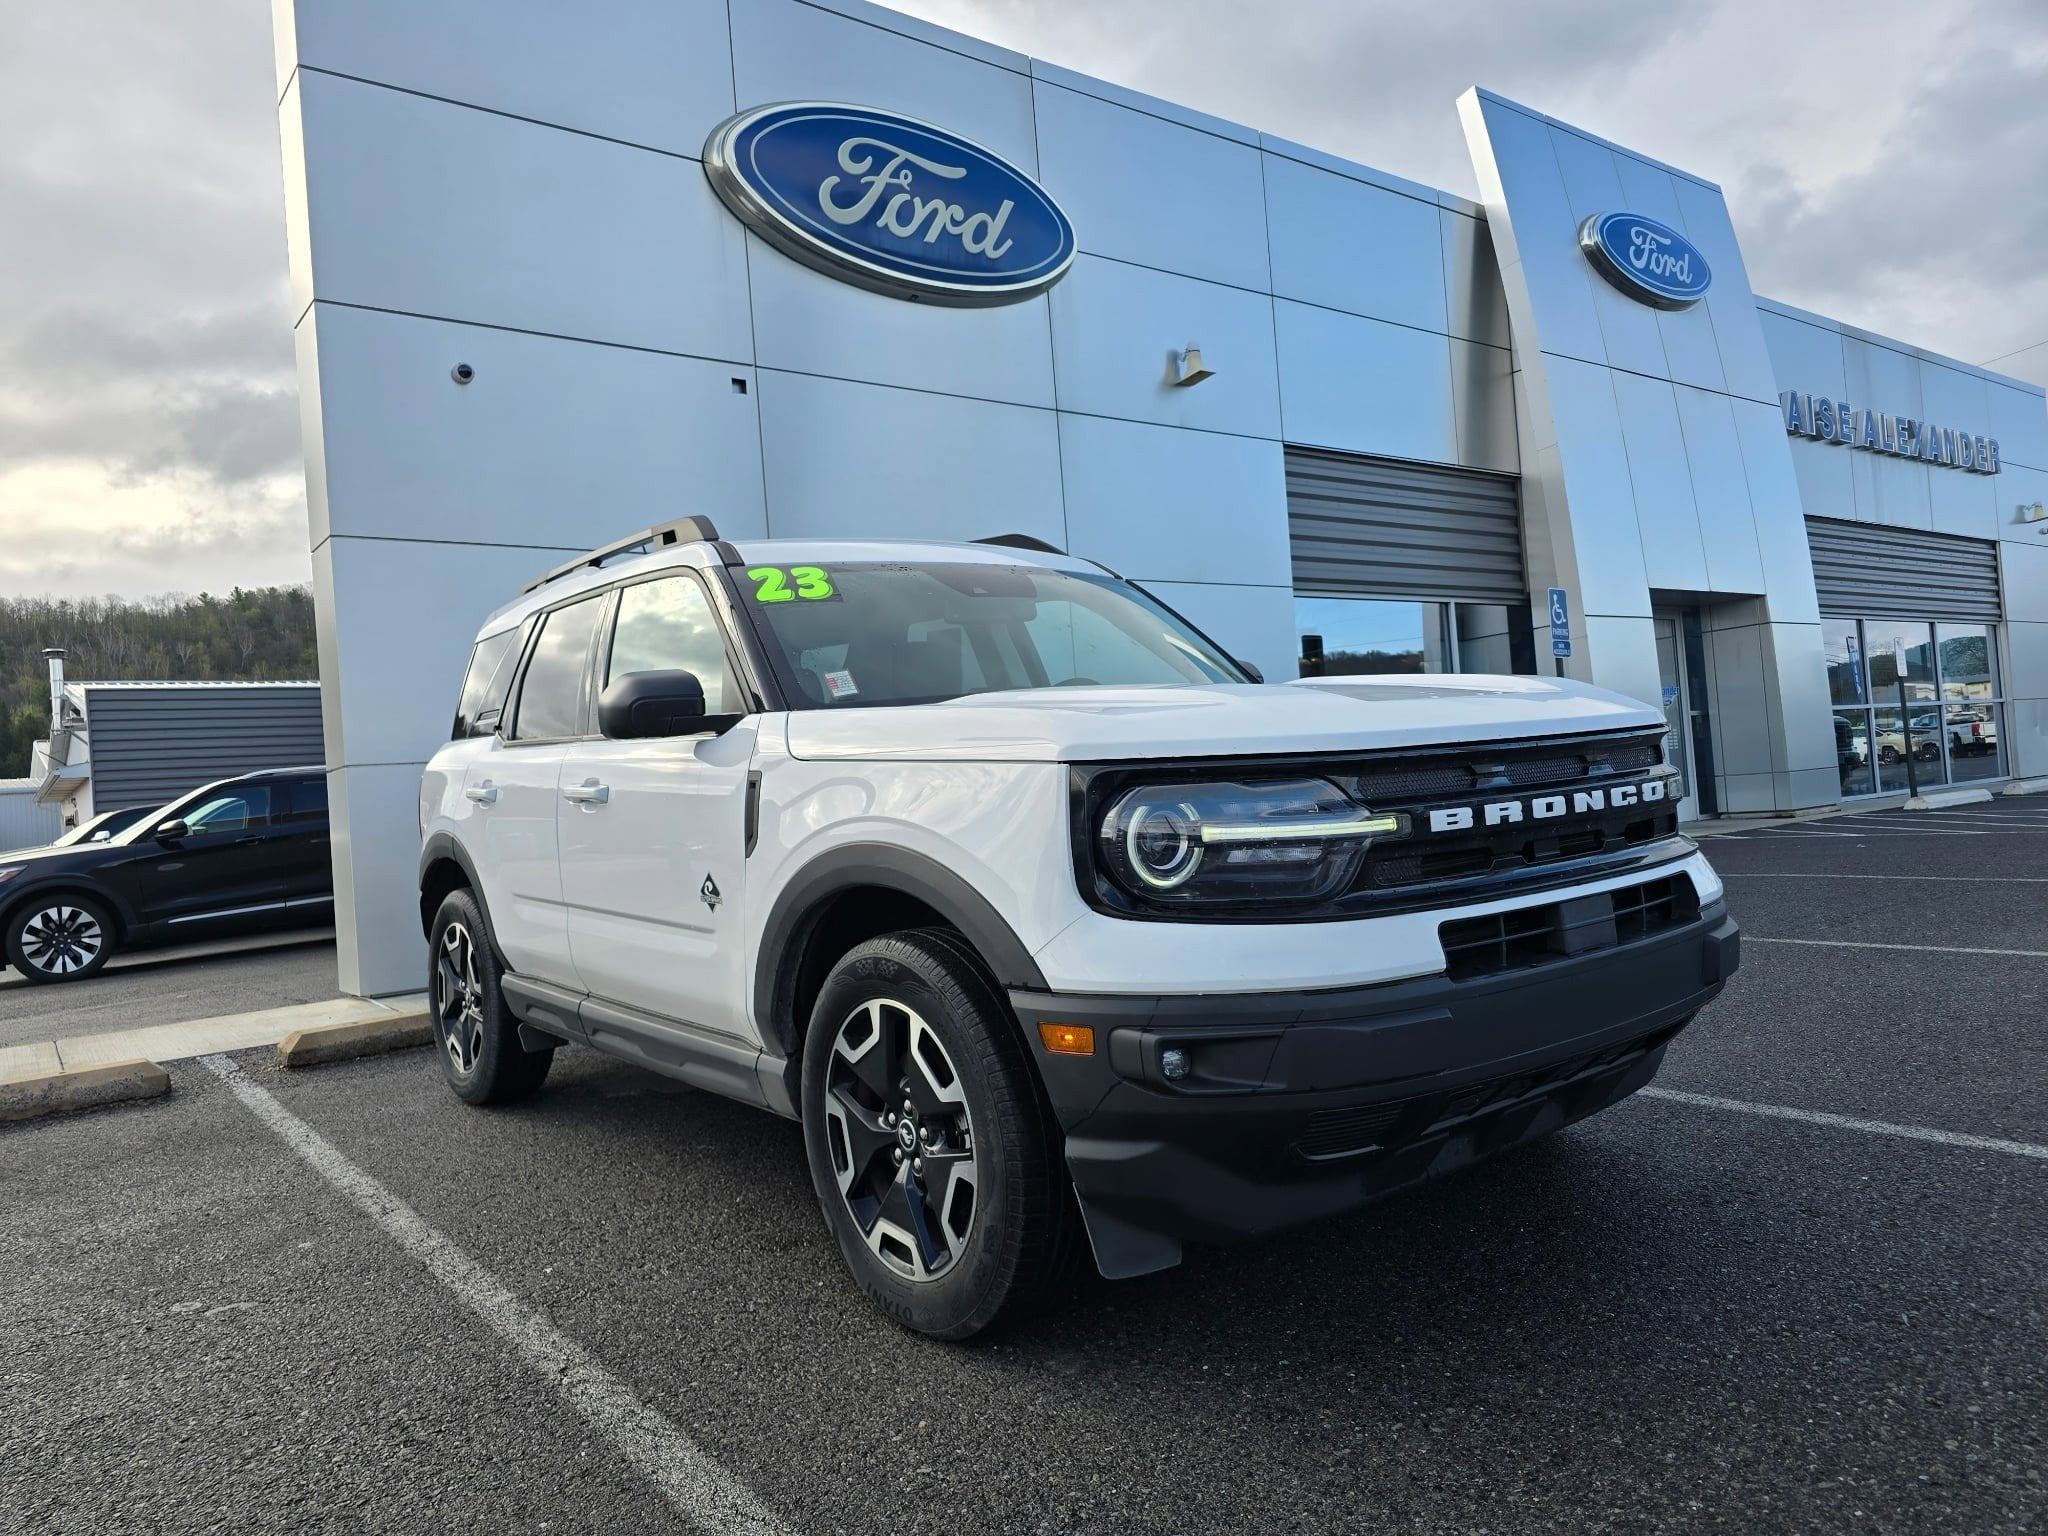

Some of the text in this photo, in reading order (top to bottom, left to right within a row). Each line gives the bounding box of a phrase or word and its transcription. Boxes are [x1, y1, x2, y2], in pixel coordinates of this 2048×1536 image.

[818, 137, 1015, 260] Ford
[1629, 226, 1693, 284] Ford
[1781, 389, 2001, 474] AISE ALEXANDER
[747, 566, 834, 603] 23
[1429, 780, 1666, 833] BRONCO
